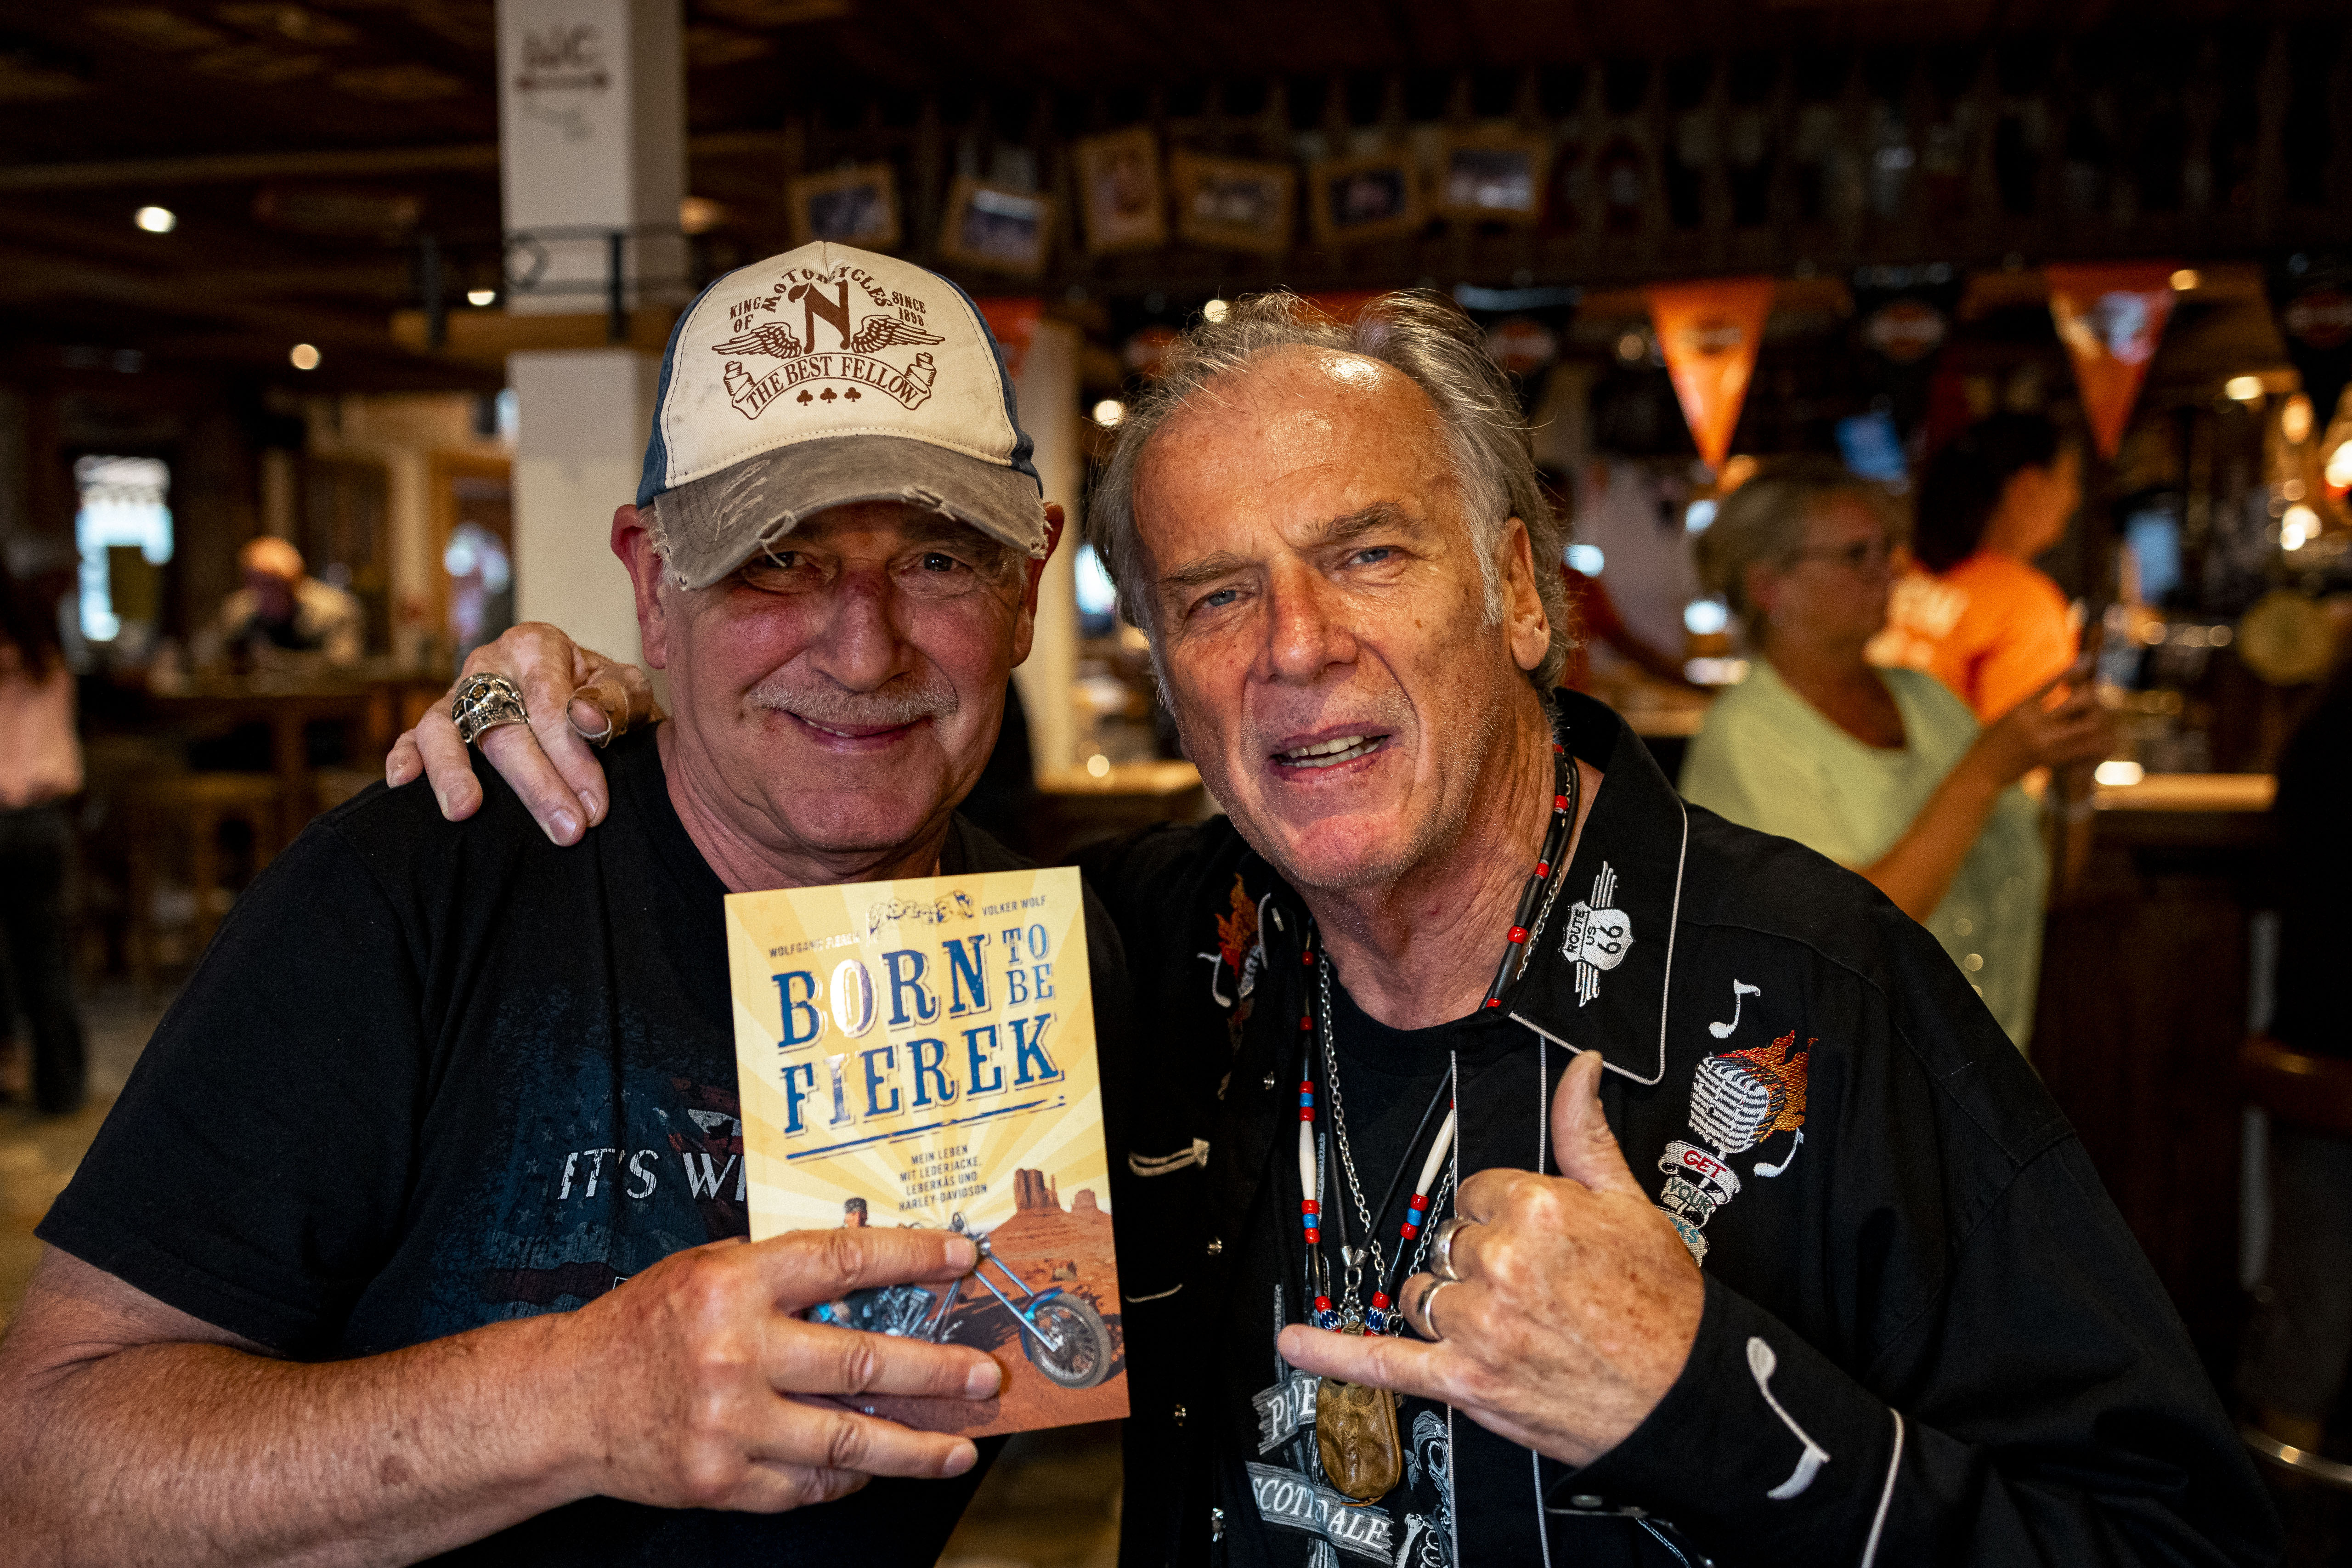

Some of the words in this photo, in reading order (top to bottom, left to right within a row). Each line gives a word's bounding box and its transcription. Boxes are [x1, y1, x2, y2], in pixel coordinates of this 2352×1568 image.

[729, 296, 763, 319] KING
[788, 279, 851, 354] N
[892, 291, 926, 314] SINCE
[734, 314, 753, 333] OF
[899, 308, 924, 327] 1898
[746, 373, 784, 413] THE
[786, 356, 833, 386] BEST
[842, 356, 919, 404] FELLOW
[982, 900, 1018, 916] VOLKER
[1020, 895, 1046, 909] WOLF
[1565, 908, 1586, 953] ROUTE
[1586, 925, 1597, 946] US
[1597, 924, 1624, 954] 66
[772, 934, 991, 1053] BORN
[1002, 923, 1049, 966] TO
[1006, 963, 1055, 1008] BE
[781, 1013, 1065, 1139] FIEREK
[911, 1151, 934, 1165] MEIN
[938, 1144, 967, 1160] LEBEN
[1683, 1150, 1727, 1178] GET
[558, 1148, 659, 1200] IT'S
[900, 1169, 916, 1182] MIT
[958, 1171, 977, 1184] UND
[899, 1184, 988, 1212] HARLEY-DAVIDSON
[1669, 1177, 1713, 1215] YOUR
